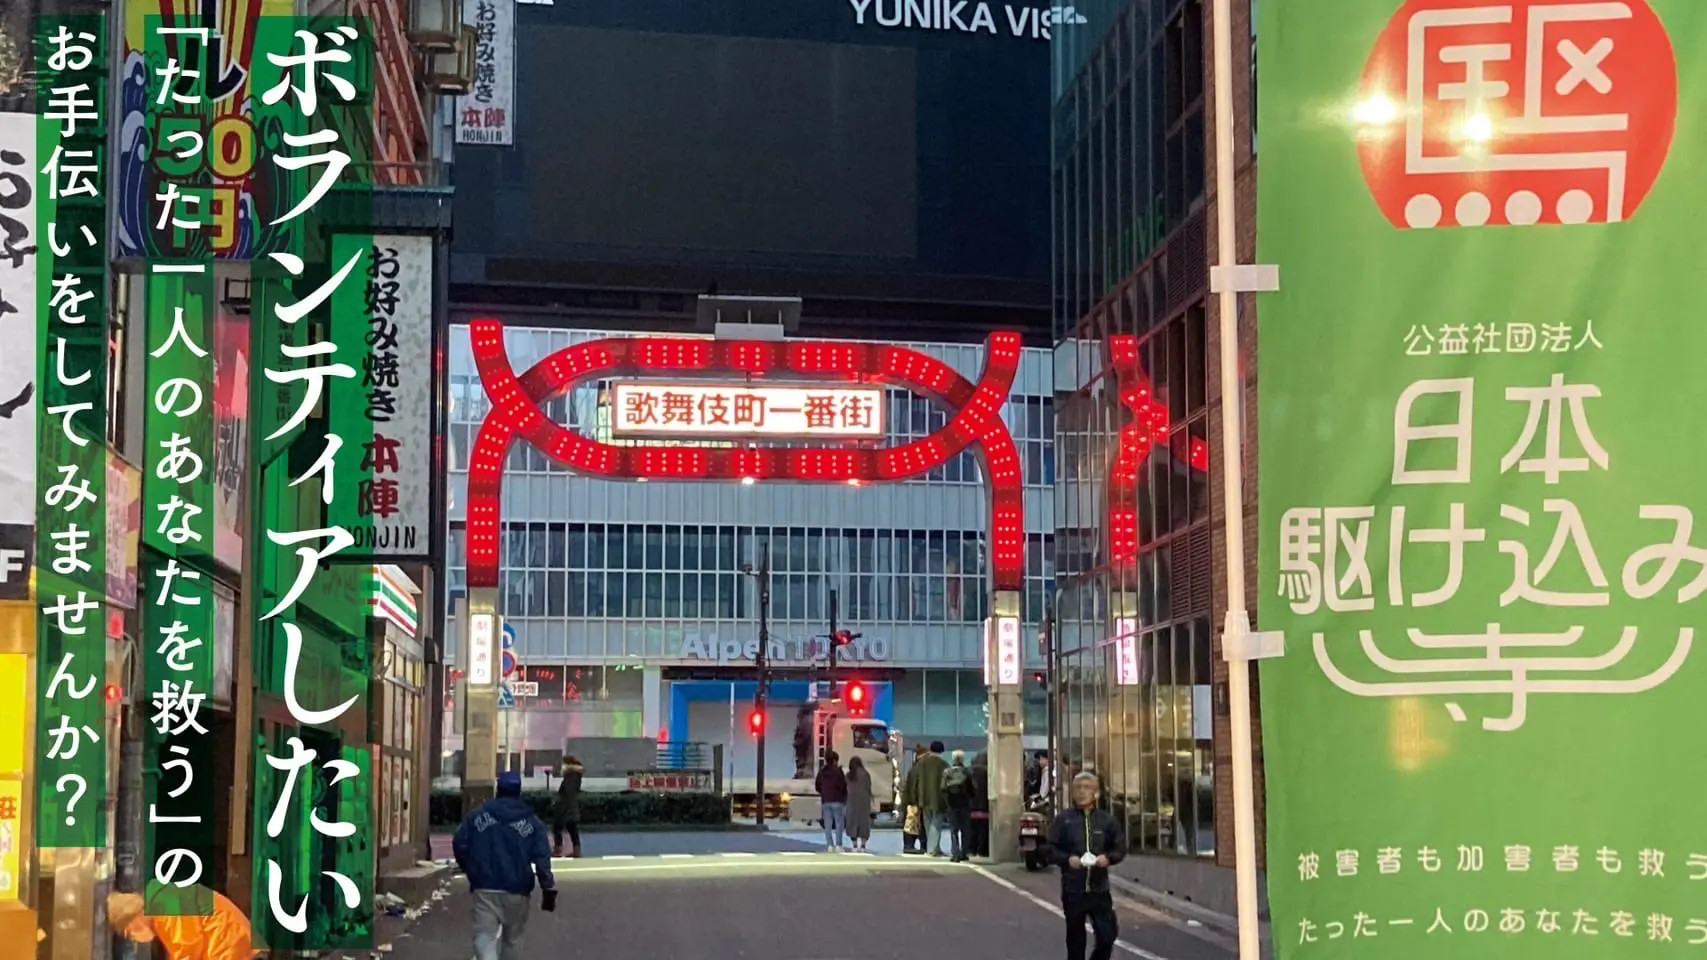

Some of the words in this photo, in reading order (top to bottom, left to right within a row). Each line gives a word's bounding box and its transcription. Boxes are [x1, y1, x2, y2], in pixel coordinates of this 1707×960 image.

[852, 0, 998, 34] YUNIKA
[474, 3, 496, 104] お好み焼き
[461, 106, 506, 129] 本陣
[462, 129, 503, 143] HONJIN
[362, 245, 401, 422] お好み焼き
[1403, 320, 1604, 357] 公益社団法人
[626, 391, 873, 428] 歌舞伎町一番街
[1392, 373, 1610, 487] 日本
[358, 433, 401, 519] 本陣
[1278, 498, 1707, 616] 駆け込み
[678, 632, 787, 667] Alpen
[1312, 622, 1695, 733] 寺
[1298, 844, 1707, 882] 被害者も加害者も救う
[1298, 908, 1707, 946] たった一人のあなたを救う
